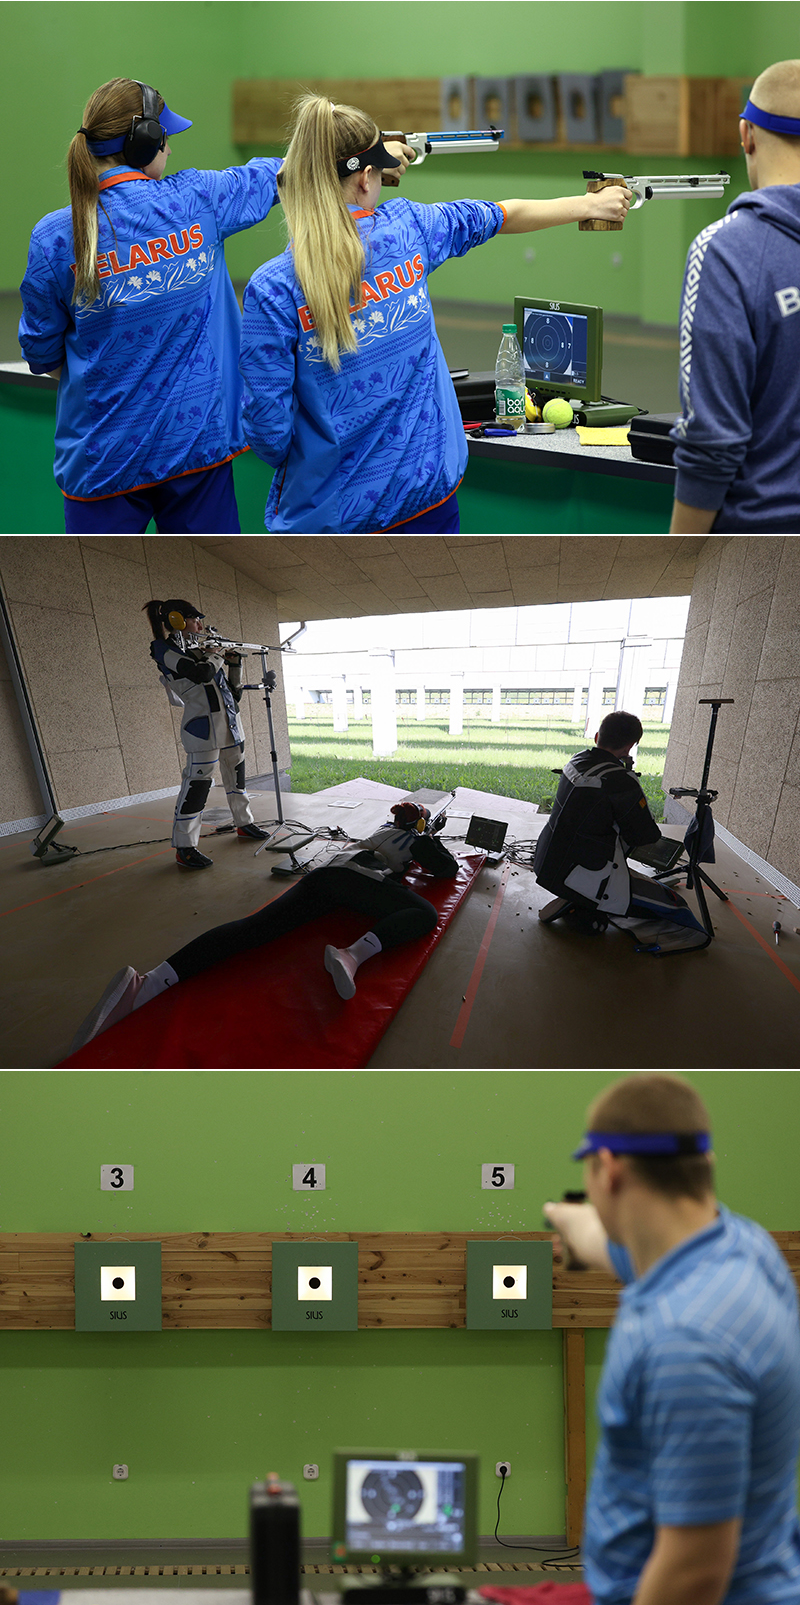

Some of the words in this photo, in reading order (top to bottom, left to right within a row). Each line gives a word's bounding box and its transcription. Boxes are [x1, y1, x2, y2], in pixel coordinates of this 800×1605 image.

[70, 223, 204, 281] ELARUS
[110, 1167, 124, 1188] 3
[302, 1167, 317, 1188] 4
[491, 1166, 505, 1187] 5
[109, 1311, 127, 1320] SIUS
[305, 1311, 323, 1320] SIUS
[501, 1309, 518, 1319] SIUS
